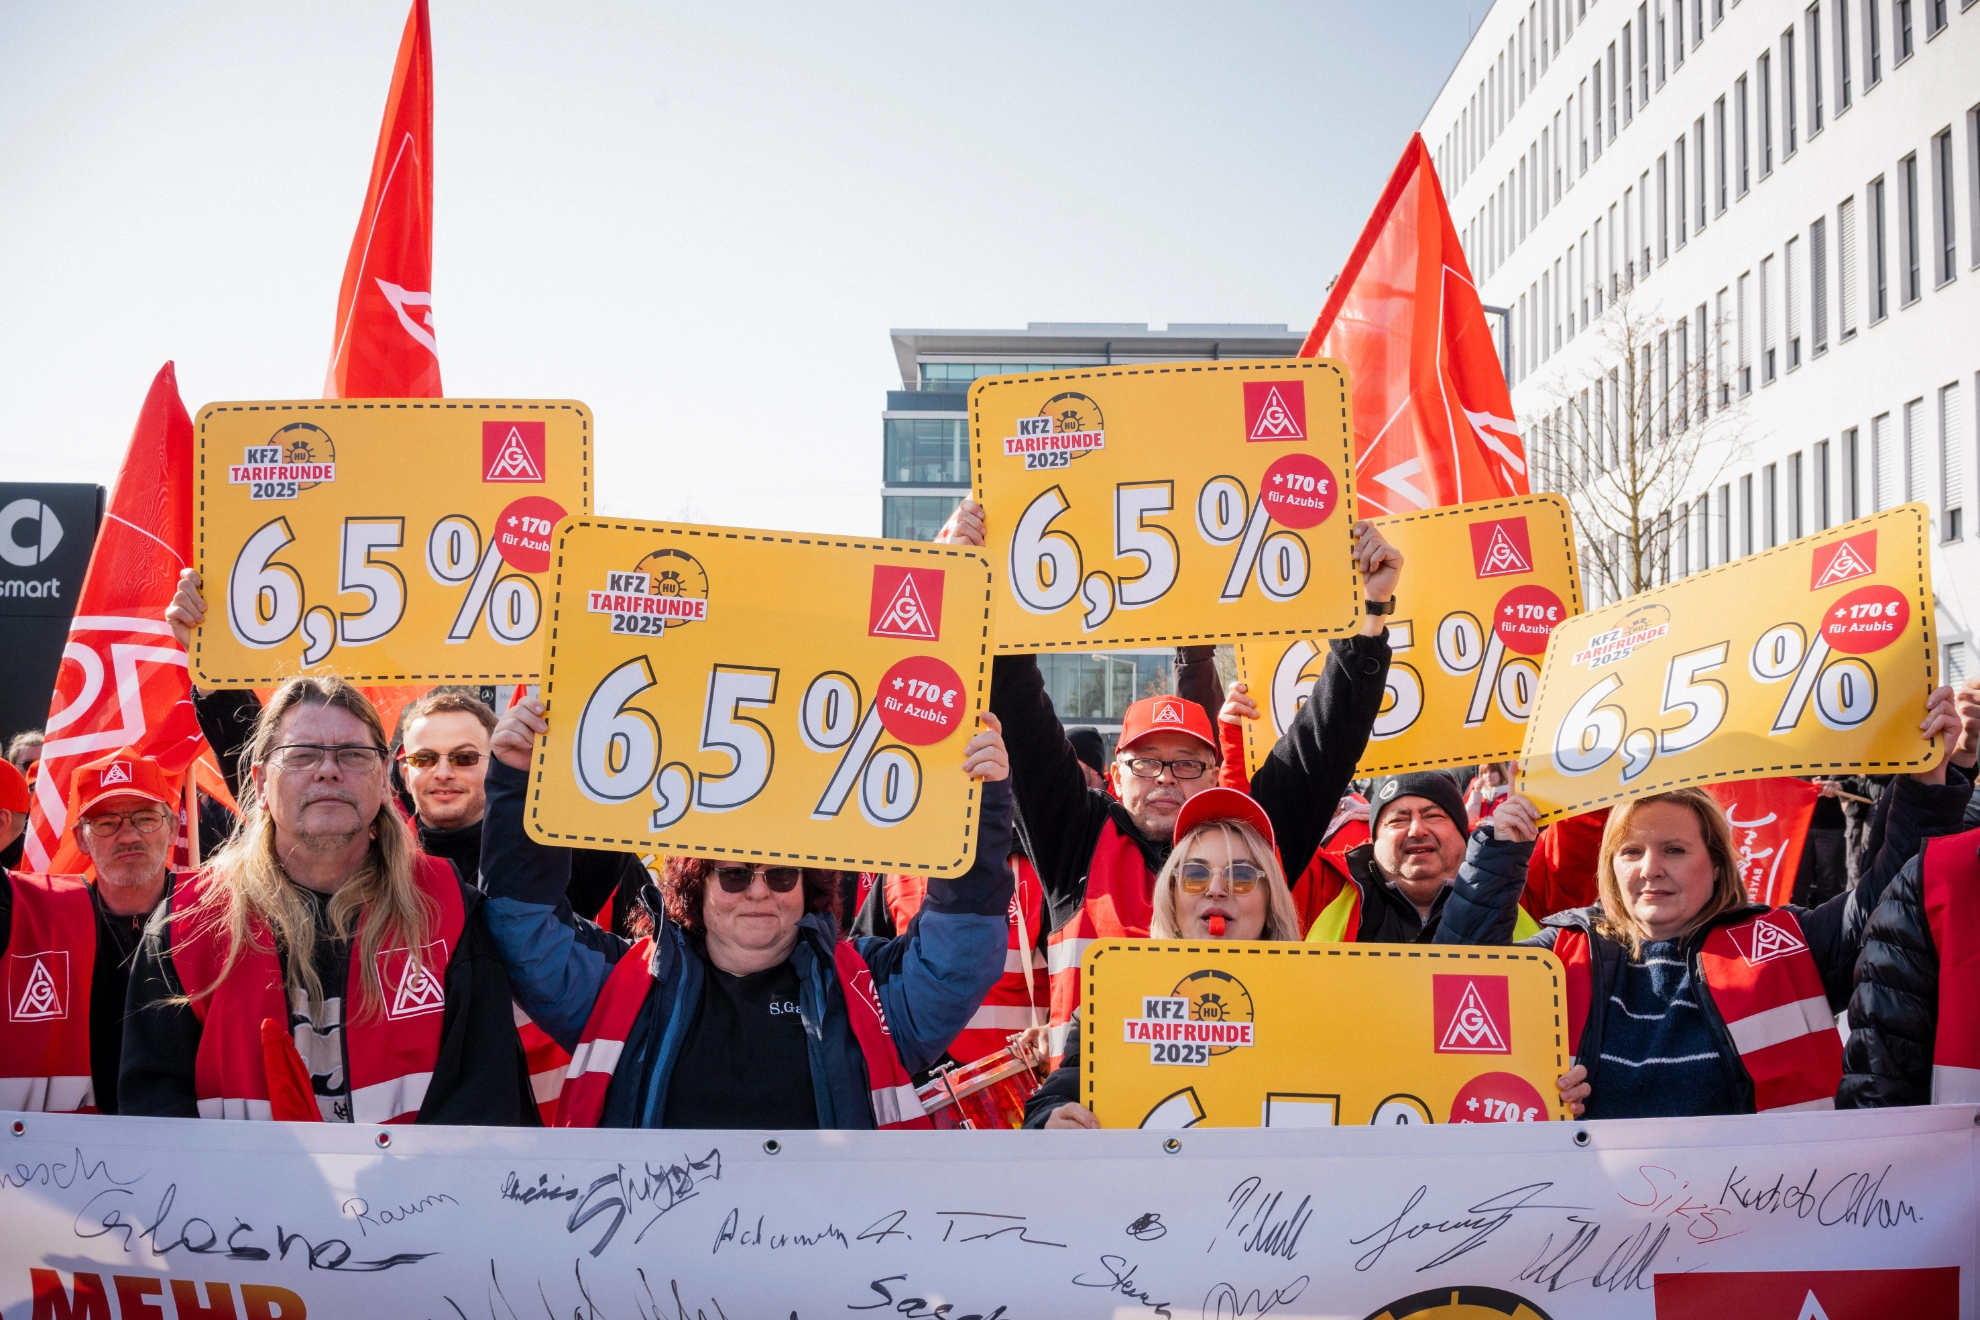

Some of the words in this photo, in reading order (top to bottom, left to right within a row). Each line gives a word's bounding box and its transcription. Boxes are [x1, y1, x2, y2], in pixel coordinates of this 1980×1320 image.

[1020, 419, 1049, 435] KFZ
[1006, 433, 1102, 453] TARIFRUNDE
[248, 448, 278, 464] KFZ
[1027, 451, 1068, 468] 2025
[232, 465, 332, 482] TARIFRUNDE
[253, 482, 296, 498] 2025
[1268, 490, 1285, 503] für
[1286, 494, 1325, 509] Azubis
[502, 532, 519, 545] für
[610, 574, 646, 594] KFZ
[591, 593, 704, 618] TARIFRUNDE
[614, 614, 662, 634] 2025
[1501, 622, 1517, 632] für
[1829, 624, 1848, 634] für
[1848, 620, 1894, 632] Azubis
[1576, 626, 1666, 662] TARIFRUNDE
[1591, 630, 1620, 648] KFZ
[1590, 647, 1631, 668] 2025
[884, 696, 904, 712] für
[904, 703, 948, 725] Azubis
[1146, 1000, 1184, 1019] KFZ
[1127, 1022, 1250, 1043] TARIFRUNDE
[1154, 1043, 1206, 1064] 2025
